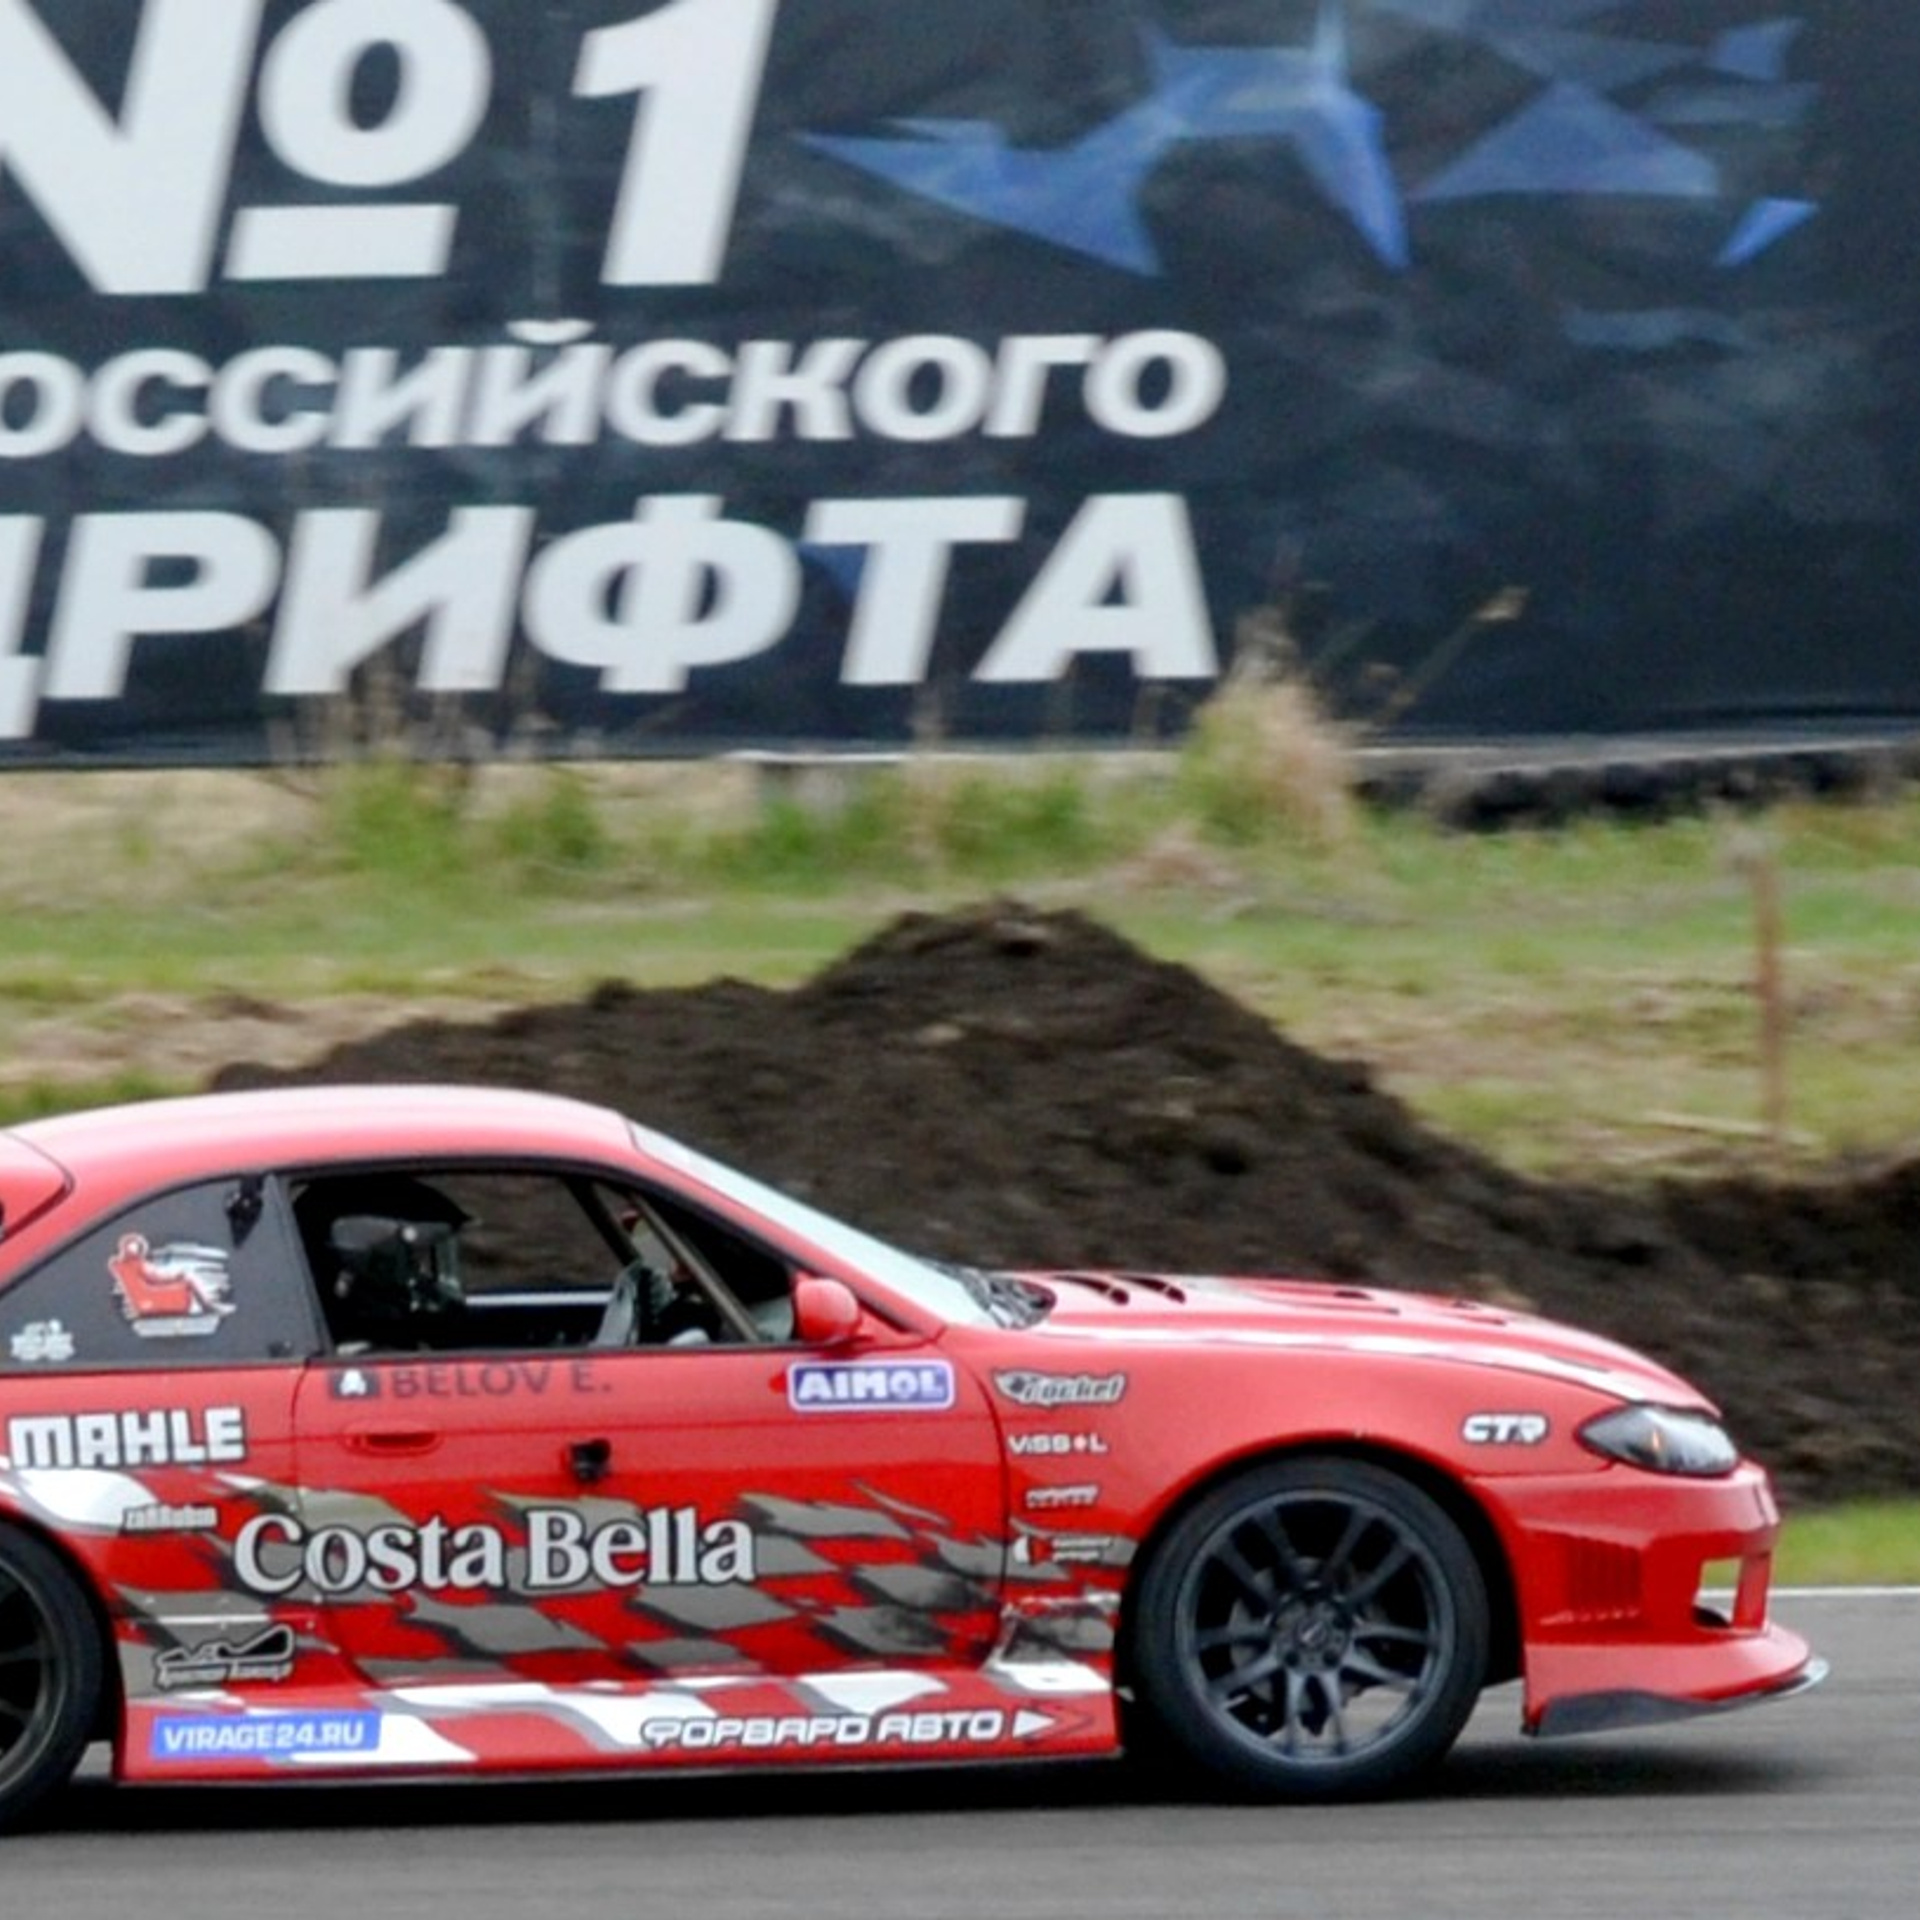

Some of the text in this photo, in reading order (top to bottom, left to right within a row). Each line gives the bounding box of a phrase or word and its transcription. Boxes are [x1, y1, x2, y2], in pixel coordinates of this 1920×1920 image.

[0, 492, 1219, 740] РИФТА
[390, 1358, 613, 1398] BELOV E.
[797, 1369, 946, 1402] AIMOL
[8, 1406, 246, 1470] MAHLE
[1463, 1413, 1548, 1443] CTR
[233, 1506, 755, 1594] Costa Bella
[163, 1720, 366, 1753] VIRAGE24.RU
